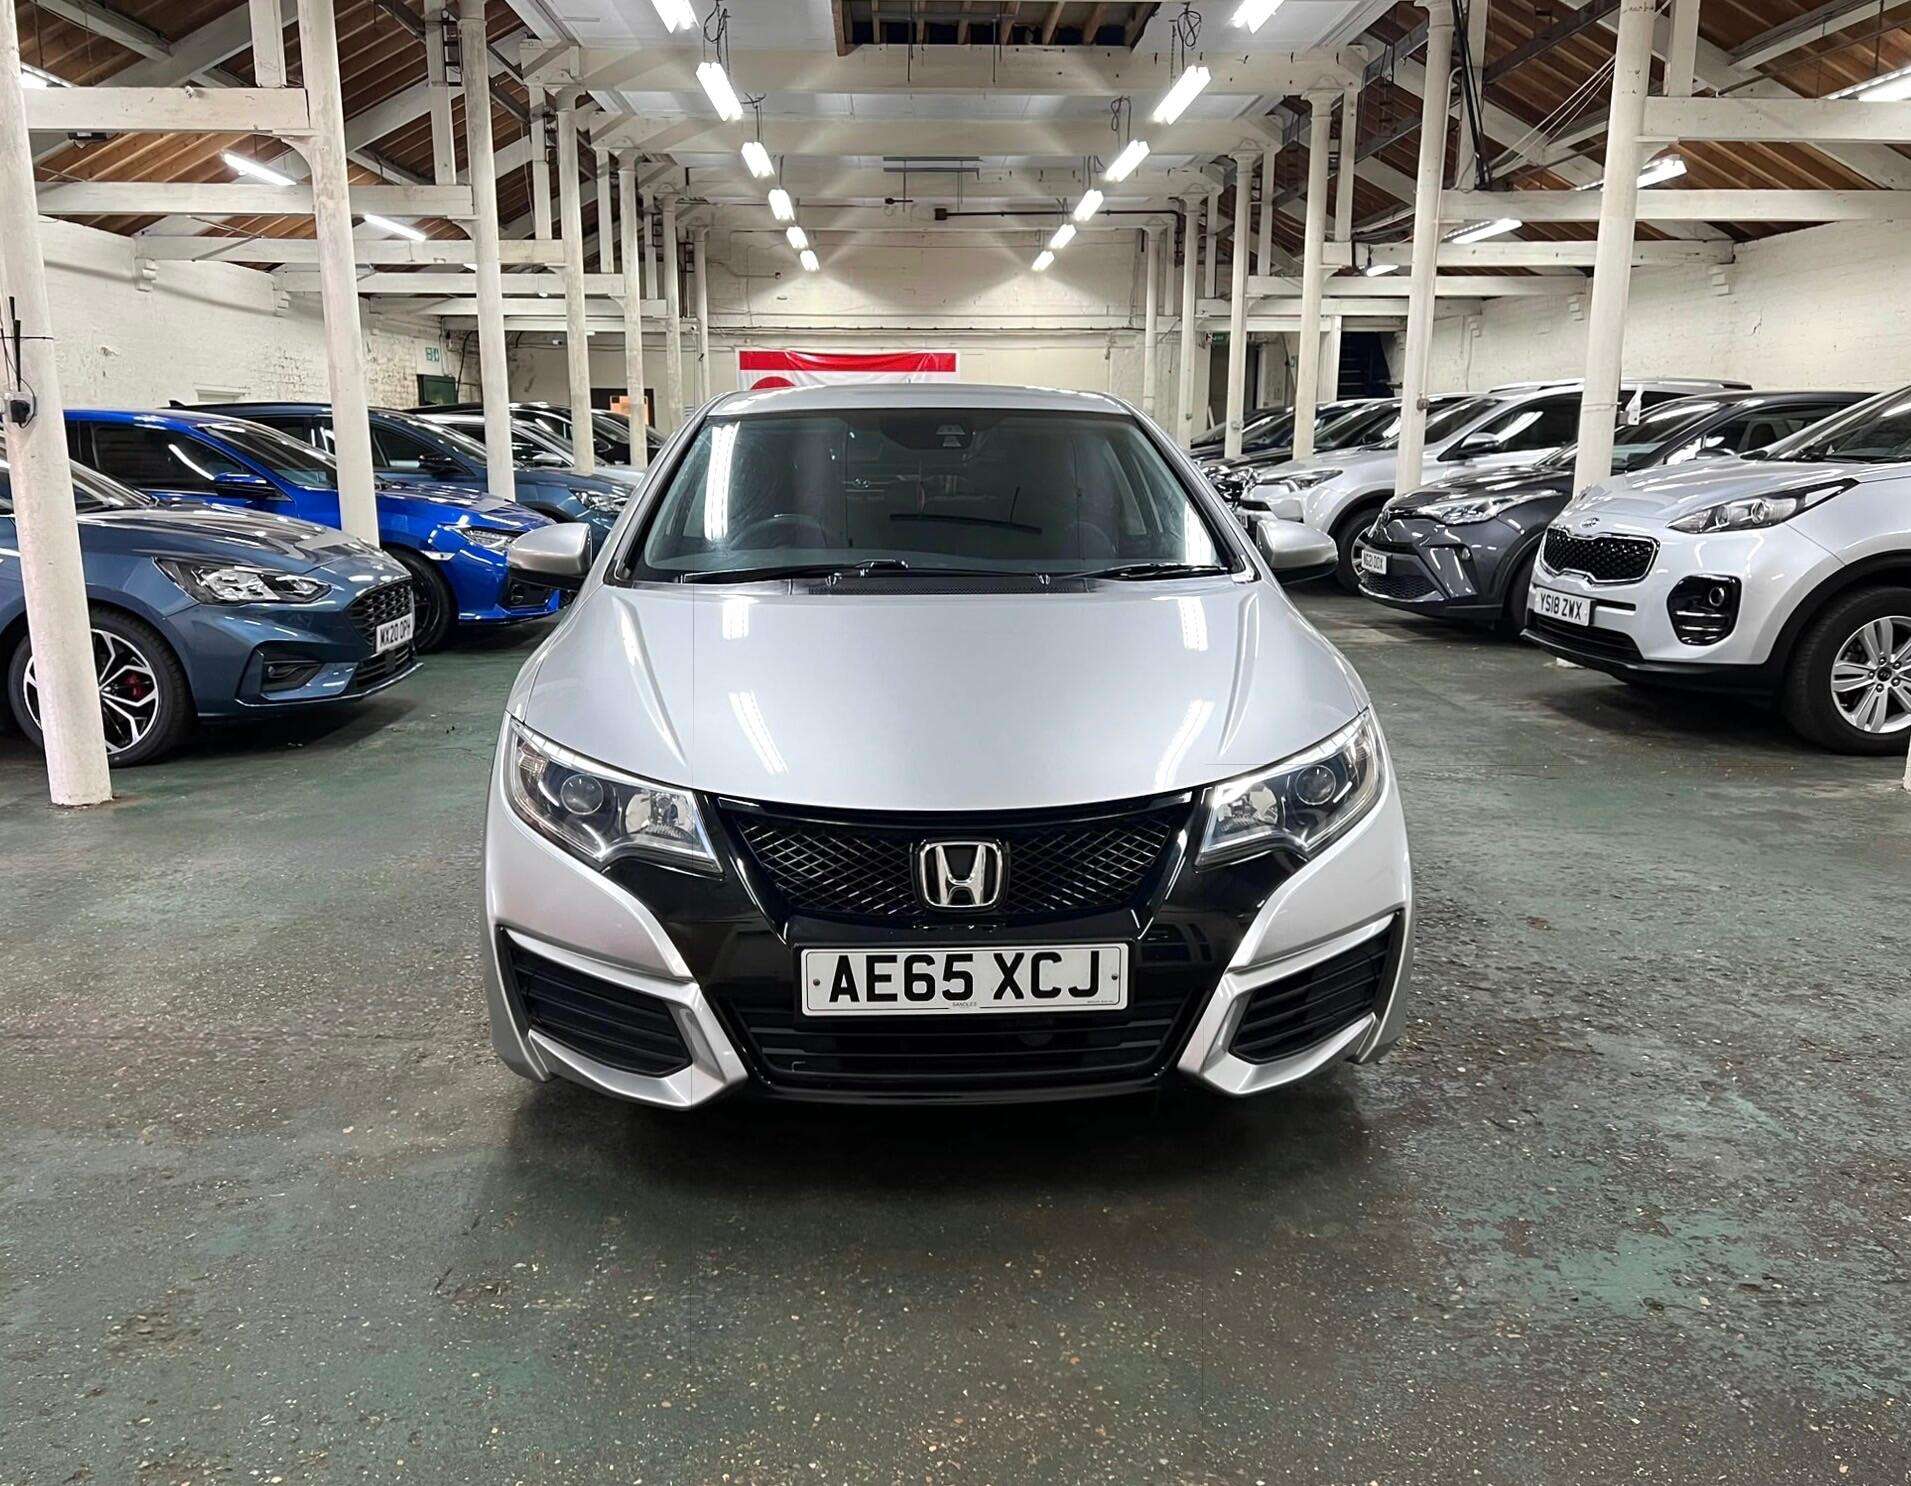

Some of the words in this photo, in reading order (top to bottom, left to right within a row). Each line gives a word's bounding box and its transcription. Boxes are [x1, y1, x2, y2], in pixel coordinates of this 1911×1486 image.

[1540, 592, 1560, 615] YS18
[1561, 598, 1583, 621] ZWX
[828, 952, 974, 1004] AE65
[993, 949, 1101, 1002] XCJ
